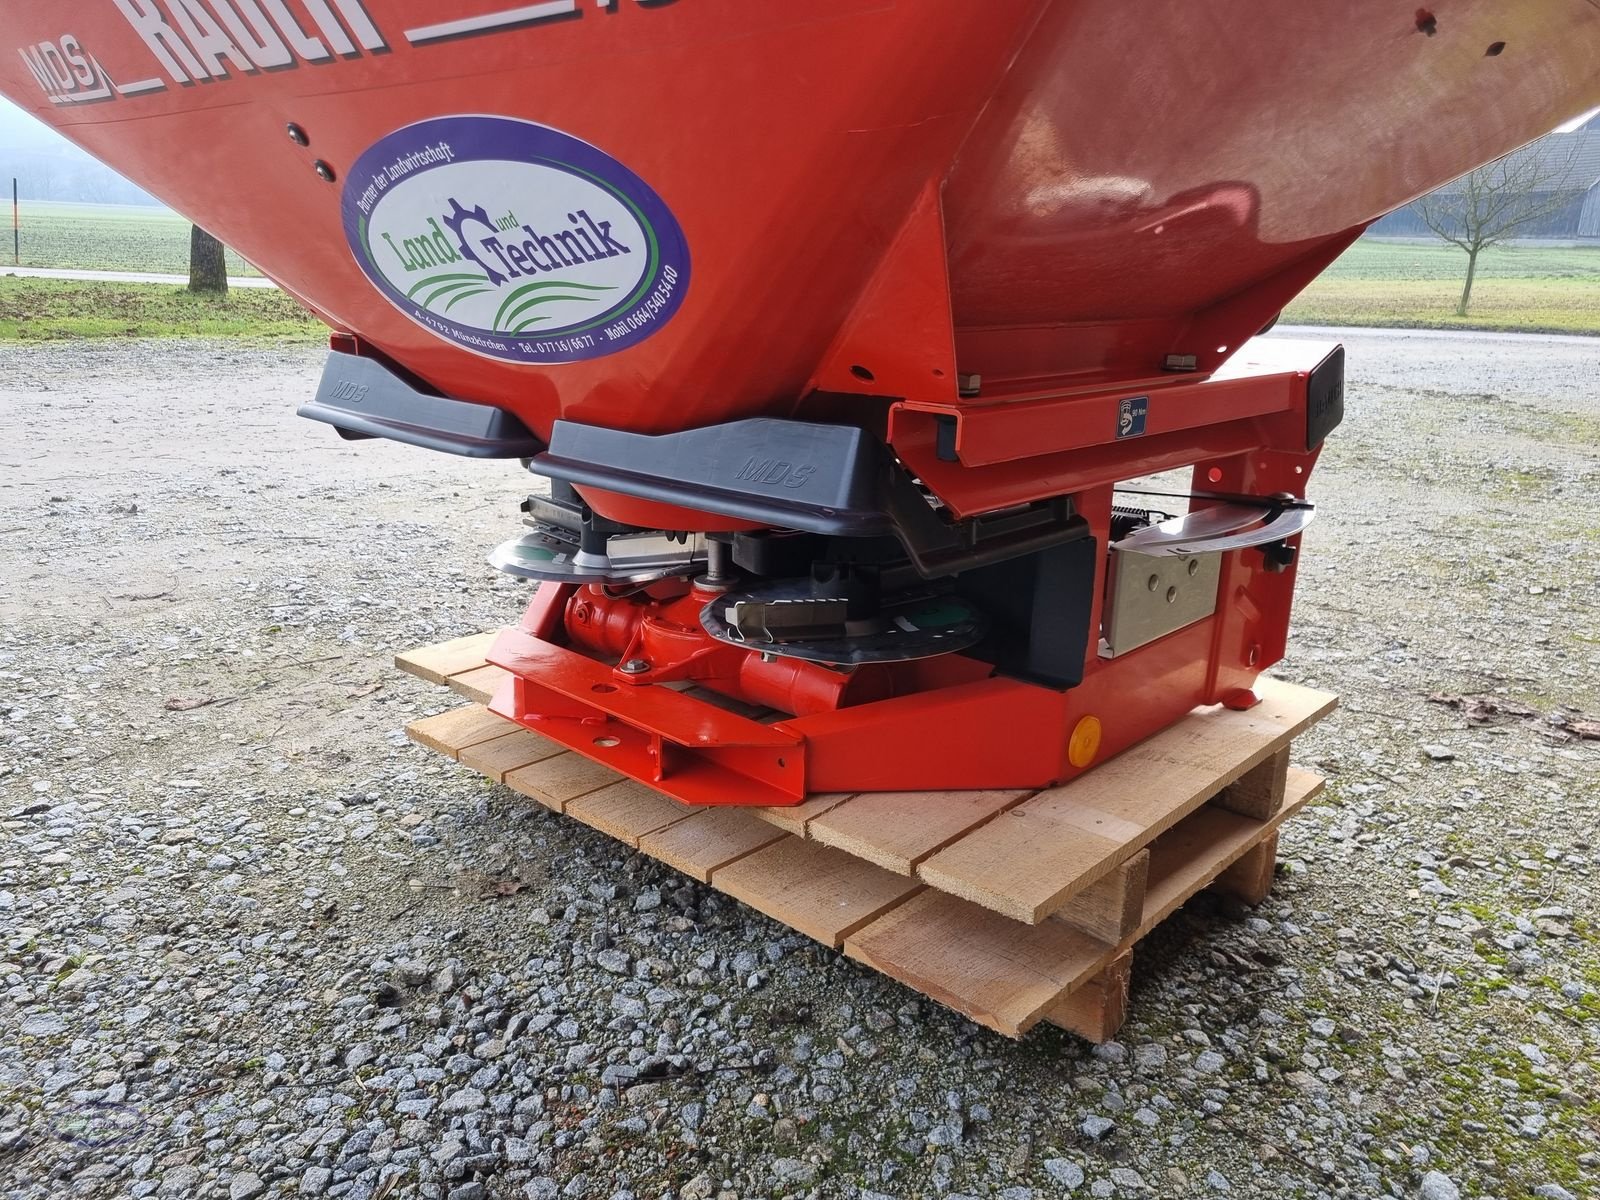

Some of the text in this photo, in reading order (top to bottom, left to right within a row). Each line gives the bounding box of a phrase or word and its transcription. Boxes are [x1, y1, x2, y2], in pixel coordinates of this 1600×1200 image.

[17, 34, 97, 93] MDS
[356, 141, 455, 215] Partner der Landwirtschaft
[381, 209, 631, 280] Land und Technik
[414, 310, 450, 335] A-4792
[451, 328, 508, 352] Münzkirchen
[518, 342, 537, 353] Tel.
[604, 320, 631, 341] Mobil
[329, 380, 369, 403] MDS
[734, 456, 817, 489] MDS
